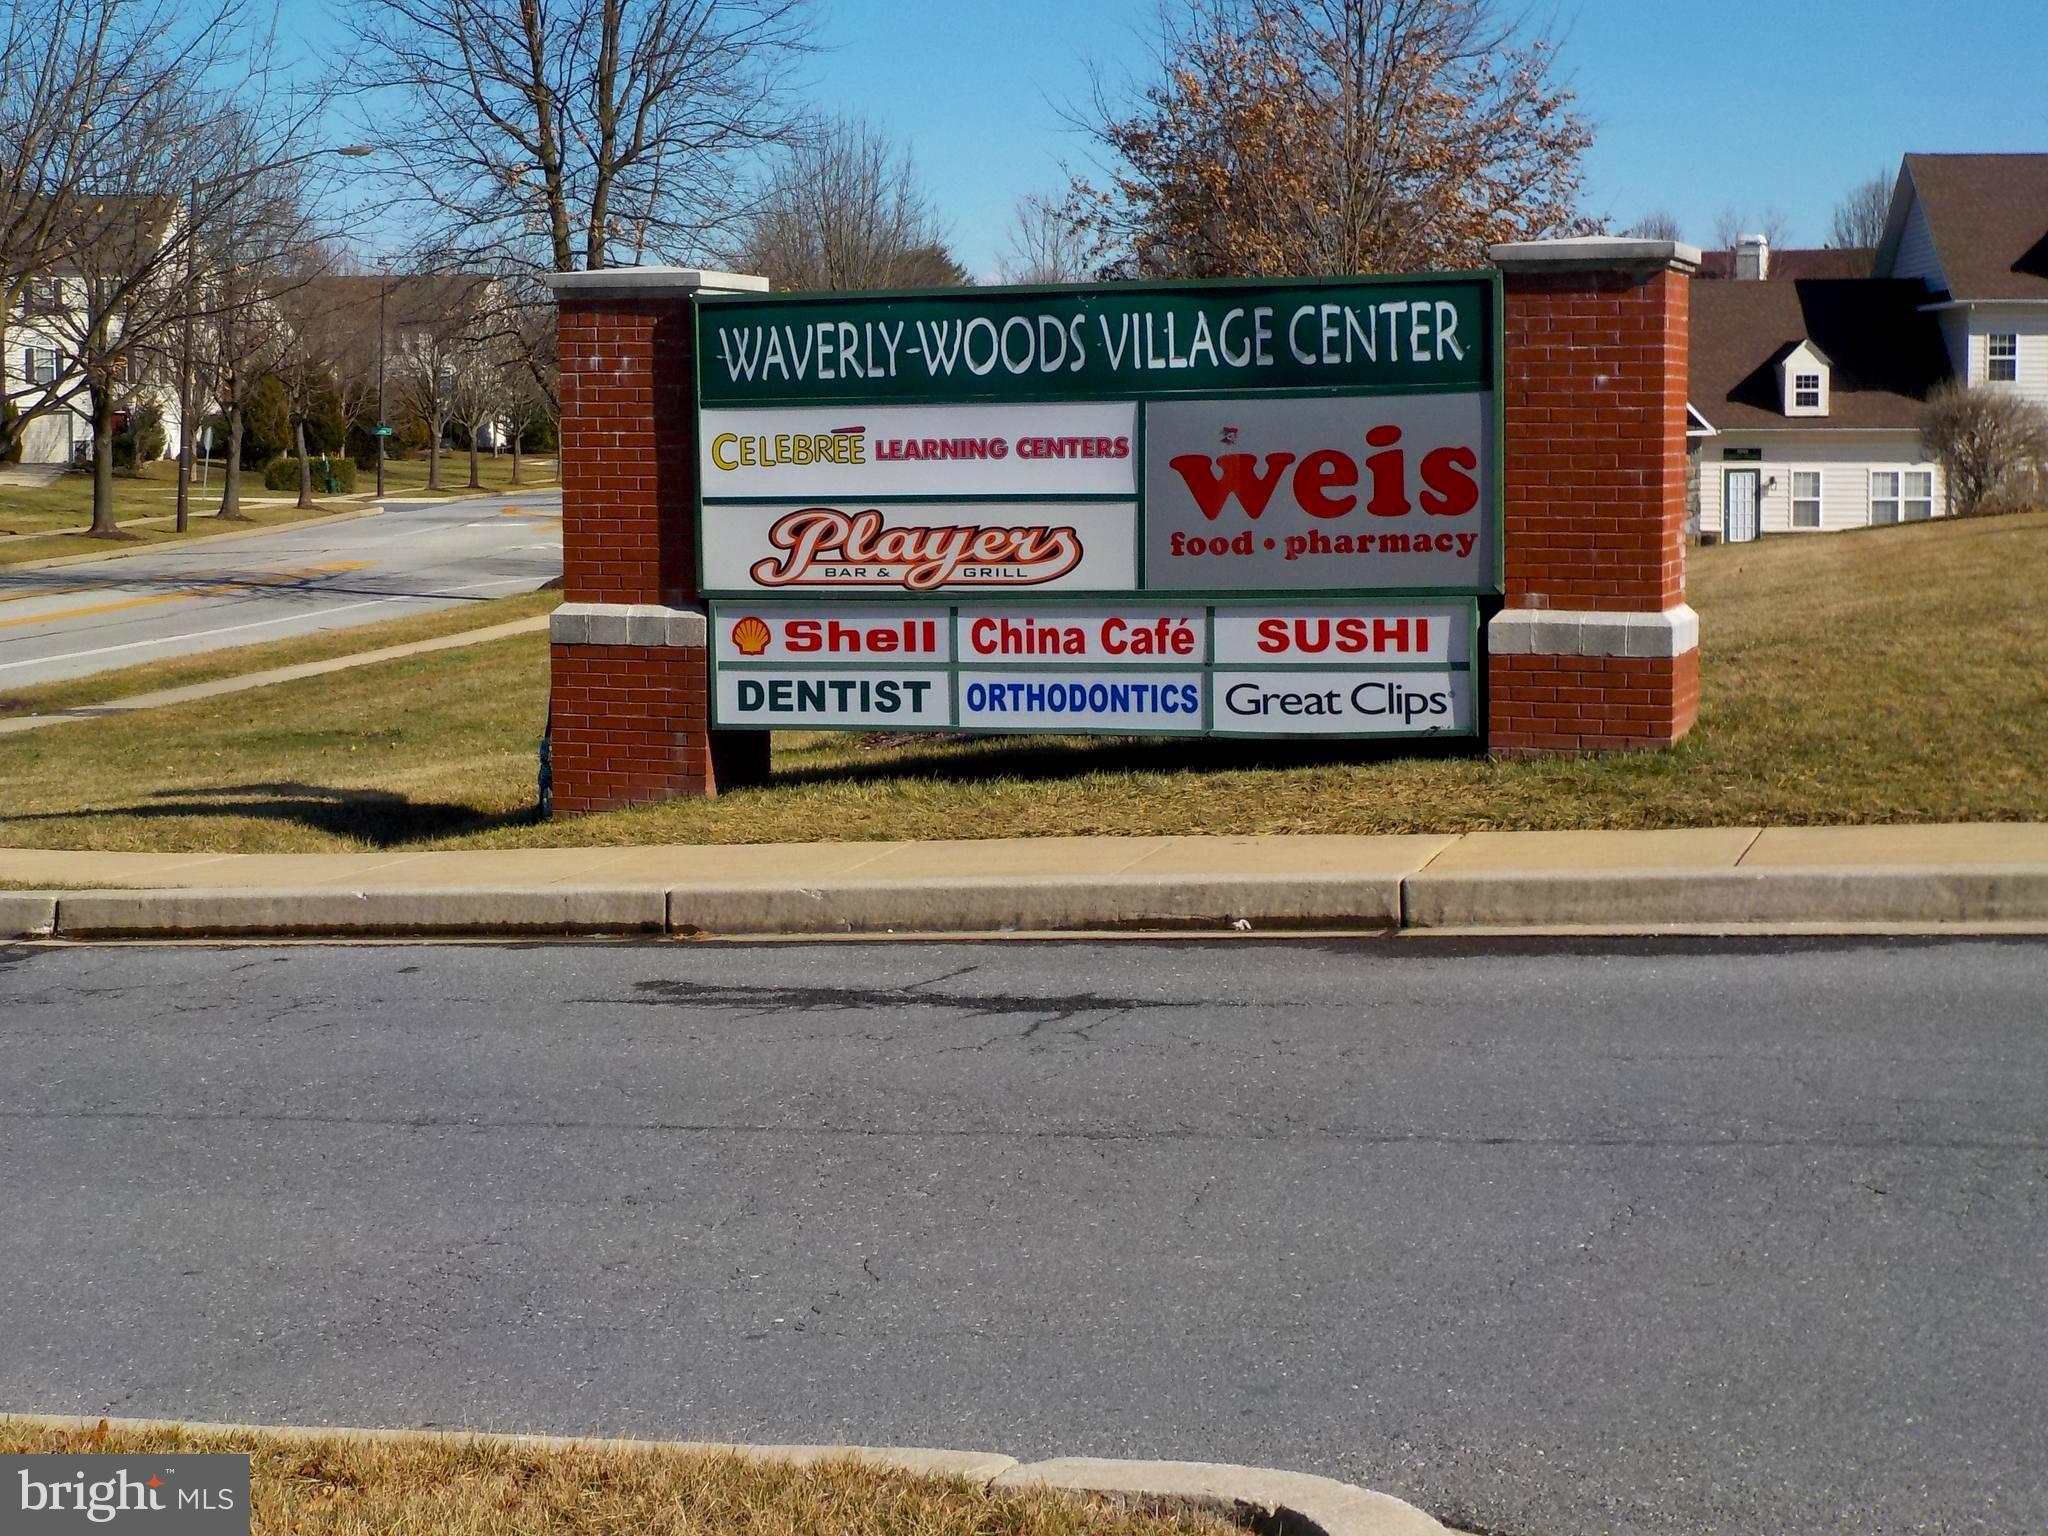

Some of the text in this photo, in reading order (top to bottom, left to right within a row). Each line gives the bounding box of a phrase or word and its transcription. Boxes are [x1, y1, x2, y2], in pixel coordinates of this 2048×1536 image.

[716, 300, 1465, 383] WAVERLY-WOODS VILLAGE CENTER
[875, 438, 1009, 461] LEARNING
[1016, 436, 1130, 459] CENTERS
[1169, 425, 1479, 520] weis
[750, 508, 1084, 590] Players
[1170, 529, 1478, 560] food pharmacy
[825, 568, 1028, 578] BAR & GRILL
[785, 621, 935, 652] Shell
[971, 617, 1195, 655] China Café
[1257, 619, 1429, 653] SUSHI
[738, 680, 931, 712] DENTIST
[967, 683, 1199, 713] ORTHODONTICS
[1225, 683, 1342, 716] Great
